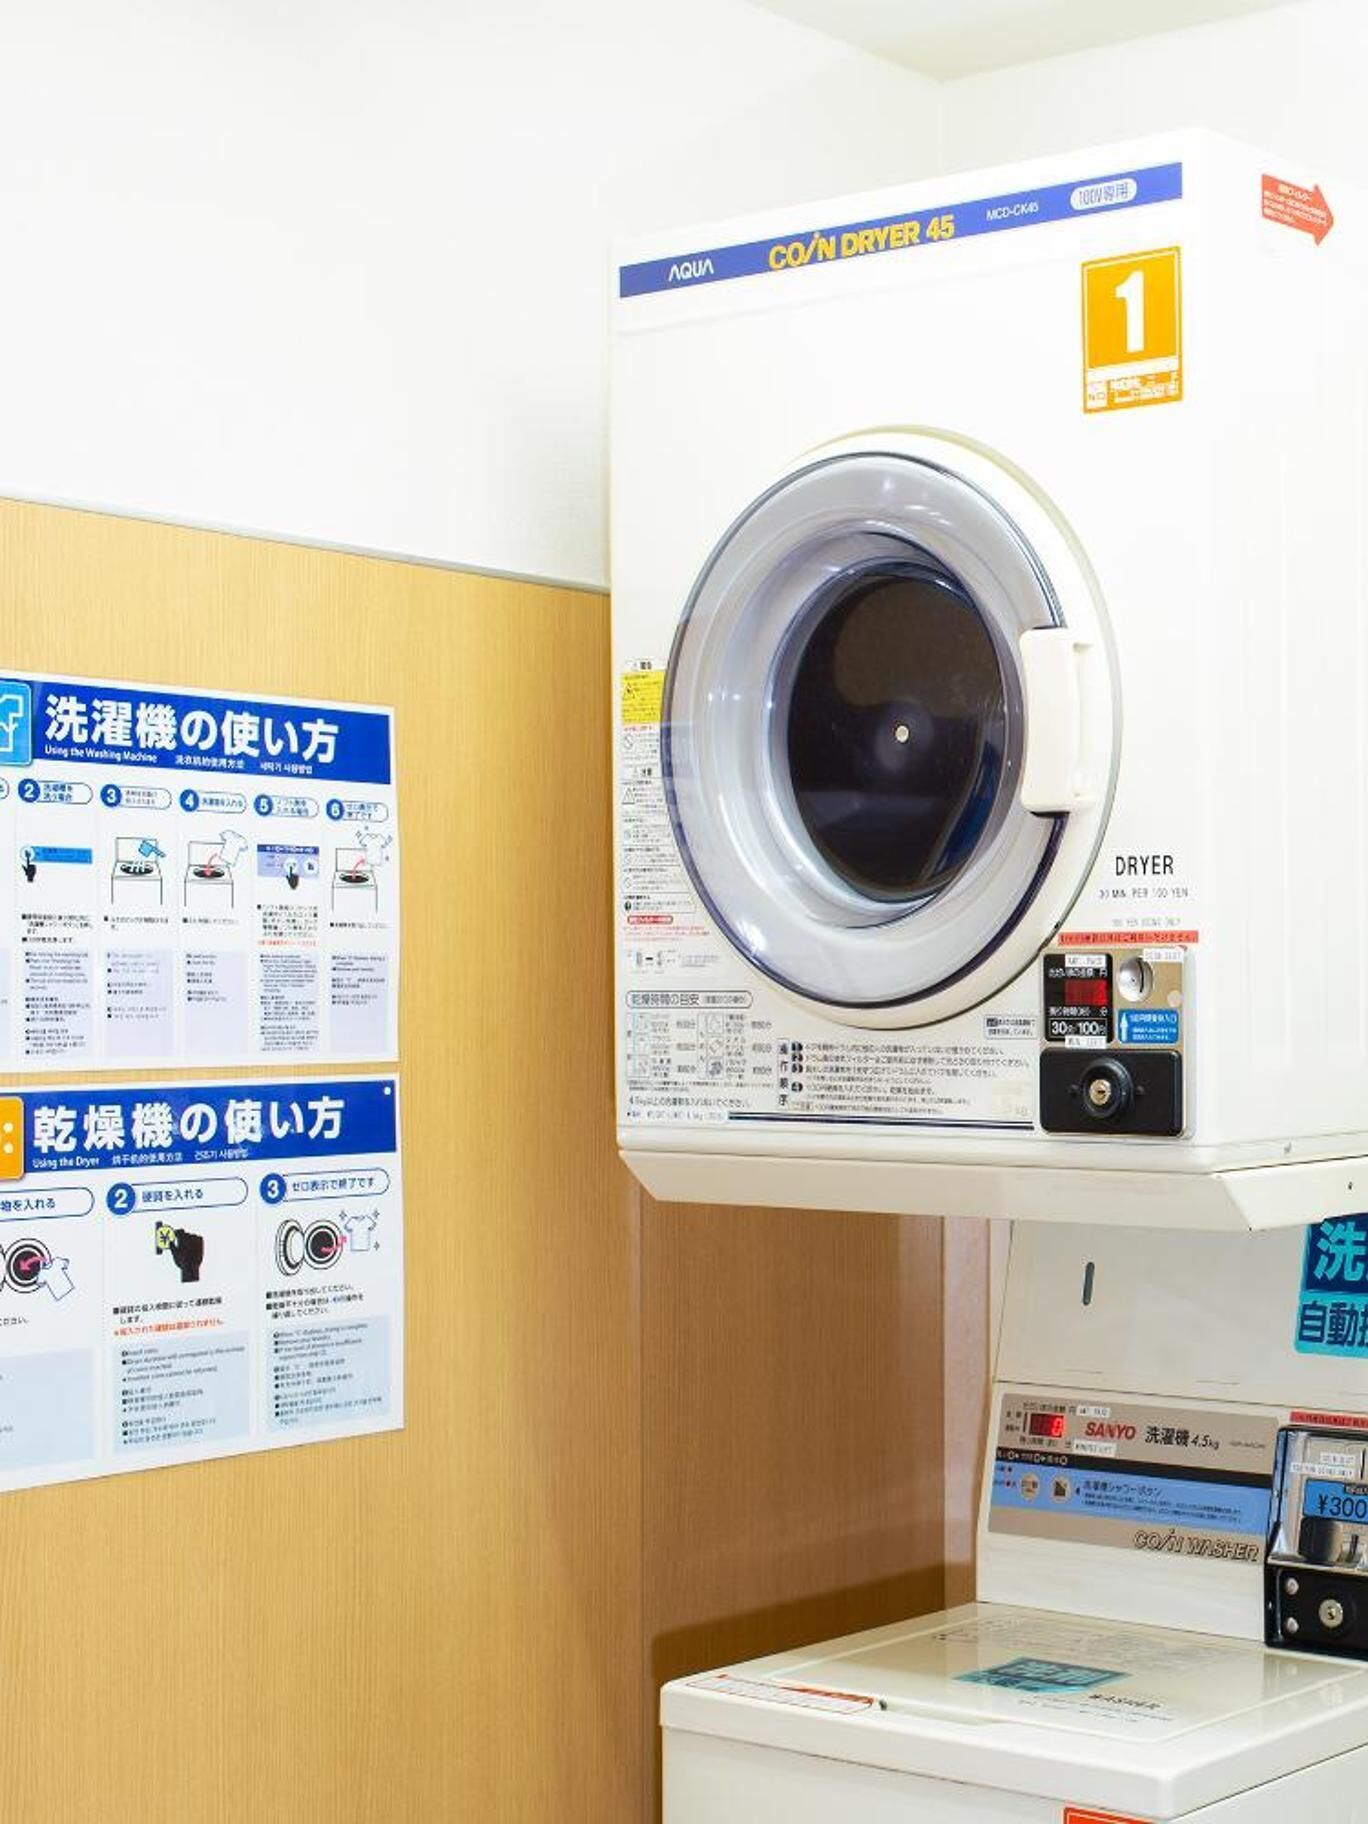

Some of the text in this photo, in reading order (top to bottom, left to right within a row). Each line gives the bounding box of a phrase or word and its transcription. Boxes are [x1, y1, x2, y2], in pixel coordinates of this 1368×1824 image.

[841, 220, 920, 257] DRYER
[927, 214, 955, 241] 45
[668, 258, 714, 282] AQUA
[1115, 270, 1146, 353] 1
[44, 693, 340, 764] 洗濯機の使い方
[44, 745, 158, 763] Using the Washing Machine
[24, 783, 35, 799] 2
[107, 788, 117, 804] 3
[185, 793, 195, 808] 4
[259, 798, 268, 812] 5
[330, 803, 340, 817] 6
[1115, 854, 1175, 876] DRYER
[1132, 888, 1149, 898] PER
[33, 1096, 345, 1153] 乾燥機の使い方
[32, 1154, 100, 1169] Using the Dryer
[267, 1180, 280, 1199] 3
[292, 1177, 376, 1192] ゼロ表示で終了です
[114, 1189, 128, 1208] 2
[1084, 1421, 1137, 1441] SANYO
[1145, 1425, 1220, 1451] 洗濯機 4.5kg
[1317, 1494, 1368, 1519] ¥300
[1185, 1536, 1261, 1563] WASHER
